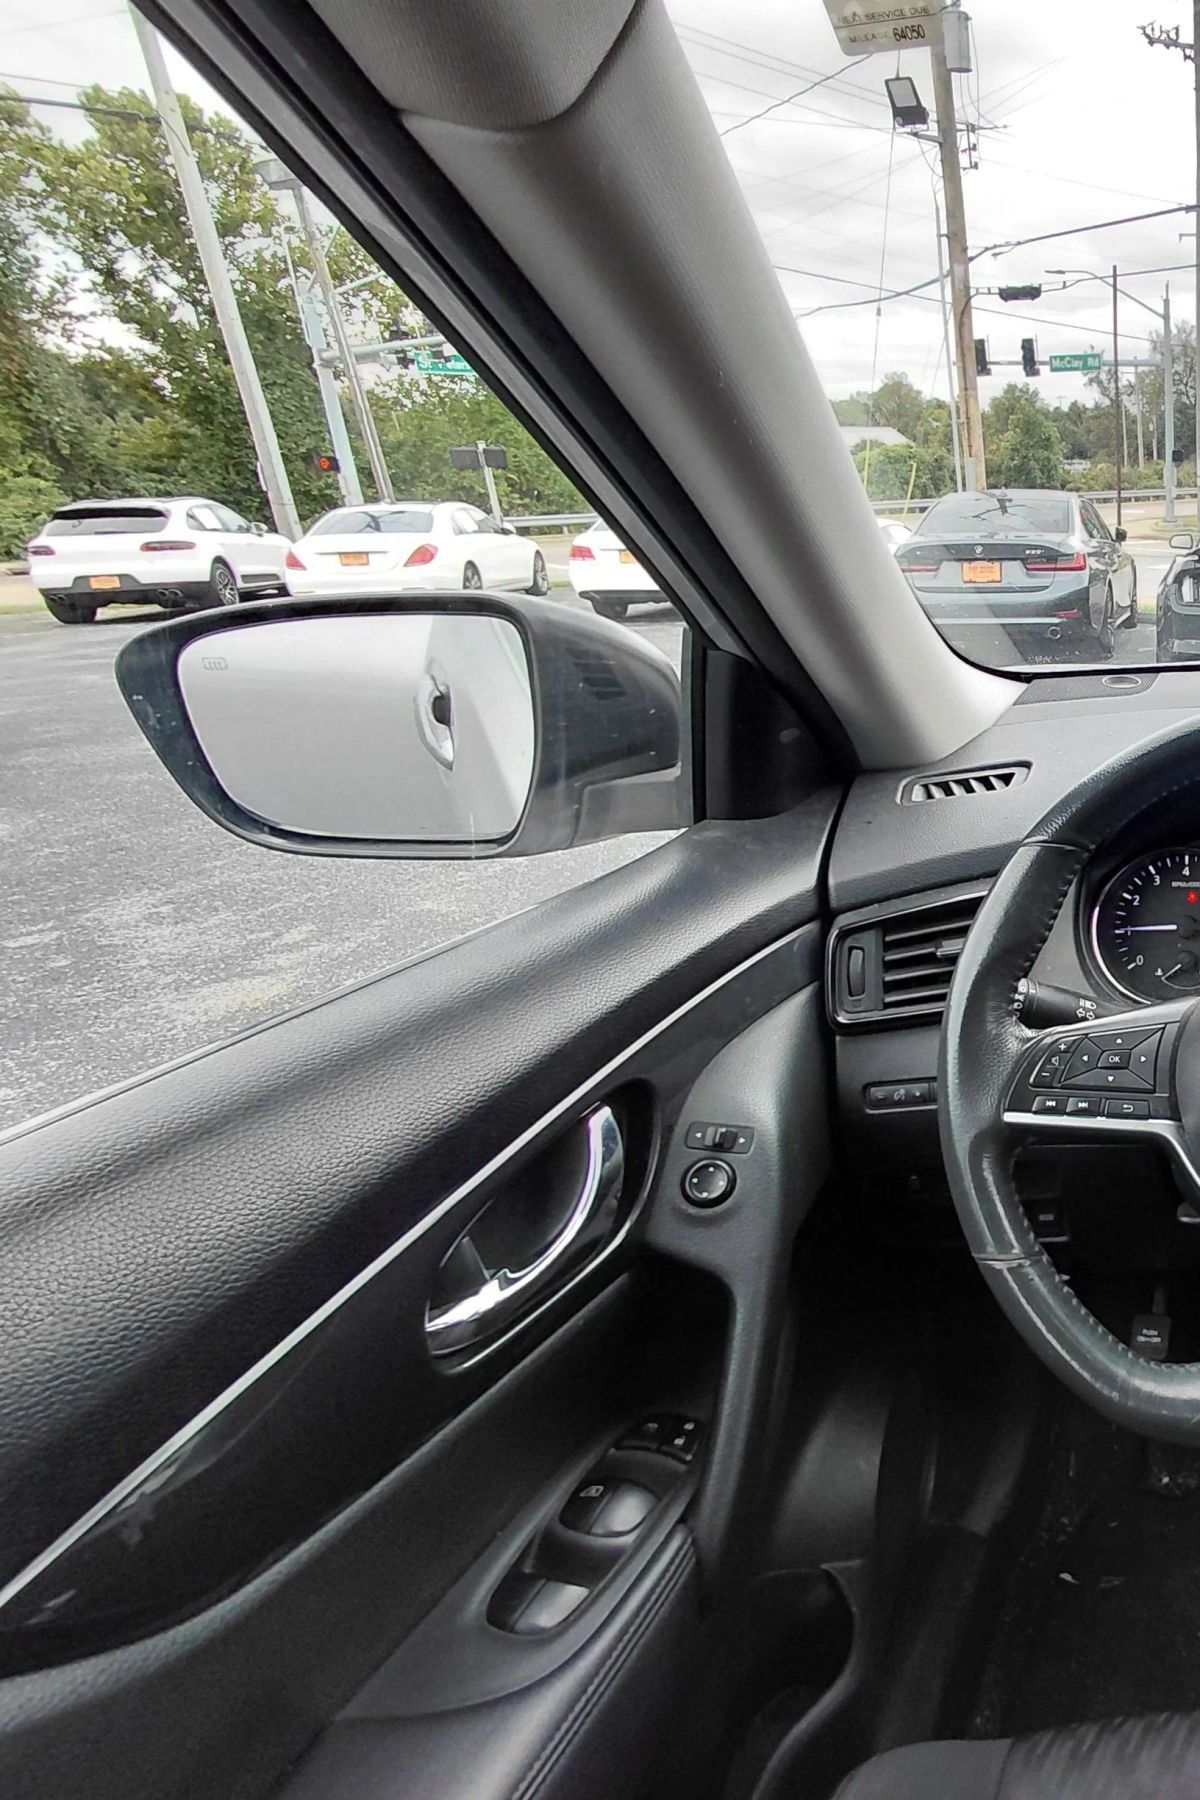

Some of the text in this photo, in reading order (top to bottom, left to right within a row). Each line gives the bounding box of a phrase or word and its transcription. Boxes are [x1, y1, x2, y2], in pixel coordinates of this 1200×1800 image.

[864, 8, 906, 21] SERVICE
[910, 5, 930, 15] DUE
[892, 23, 926, 42] 64050
[1182, 868, 1191, 878] 4
[1153, 875, 1162, 887] 3
[1132, 894, 1142, 907] 2
[1108, 1055, 1121, 1064] OK
